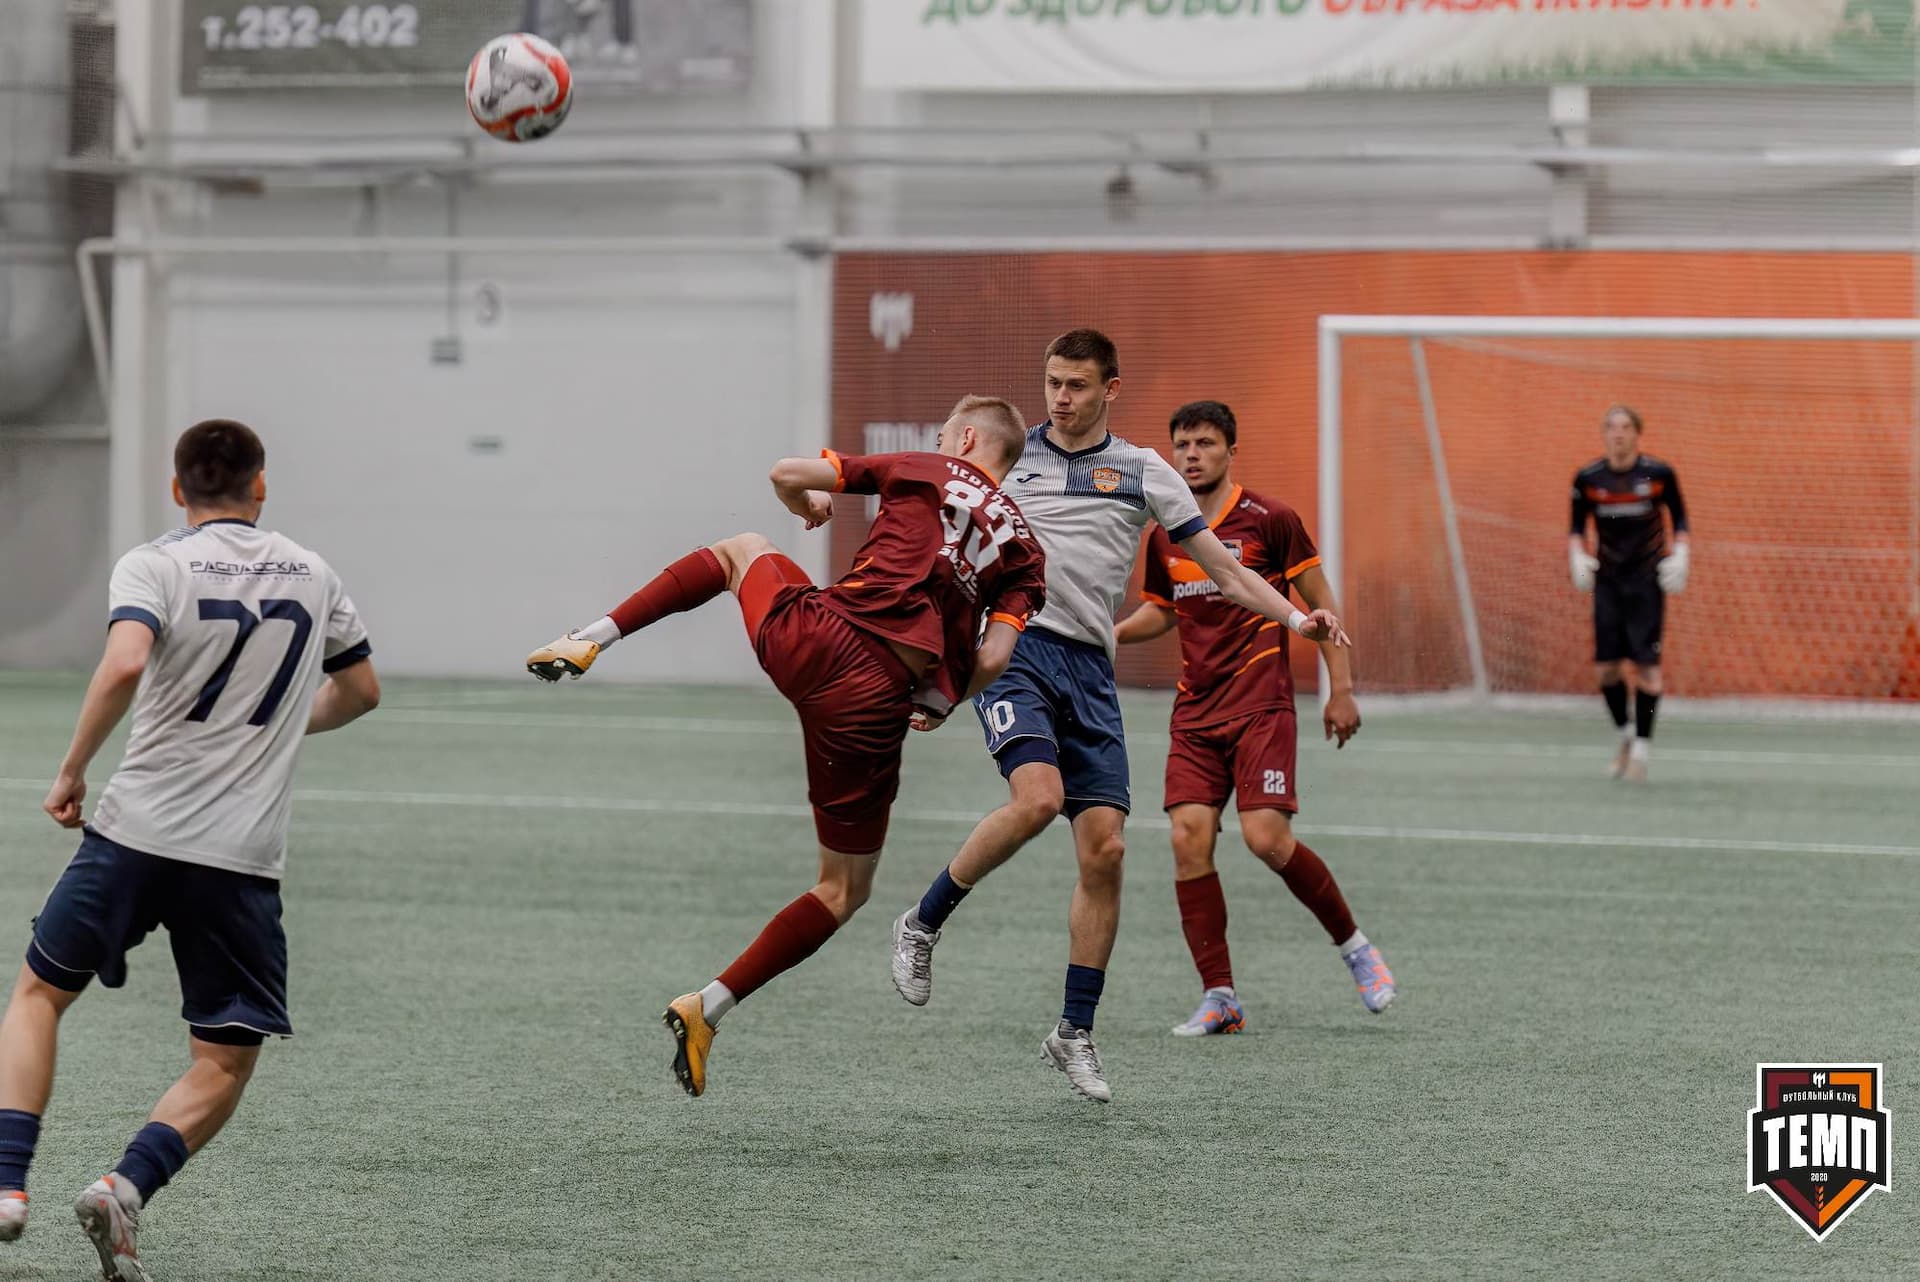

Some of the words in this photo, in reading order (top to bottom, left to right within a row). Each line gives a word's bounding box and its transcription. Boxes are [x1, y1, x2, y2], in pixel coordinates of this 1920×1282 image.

[201, 4, 418, 49] т.252-402
[184, 599, 313, 727] 77
[985, 701, 1016, 742] 10
[1263, 769, 1286, 795] 22
